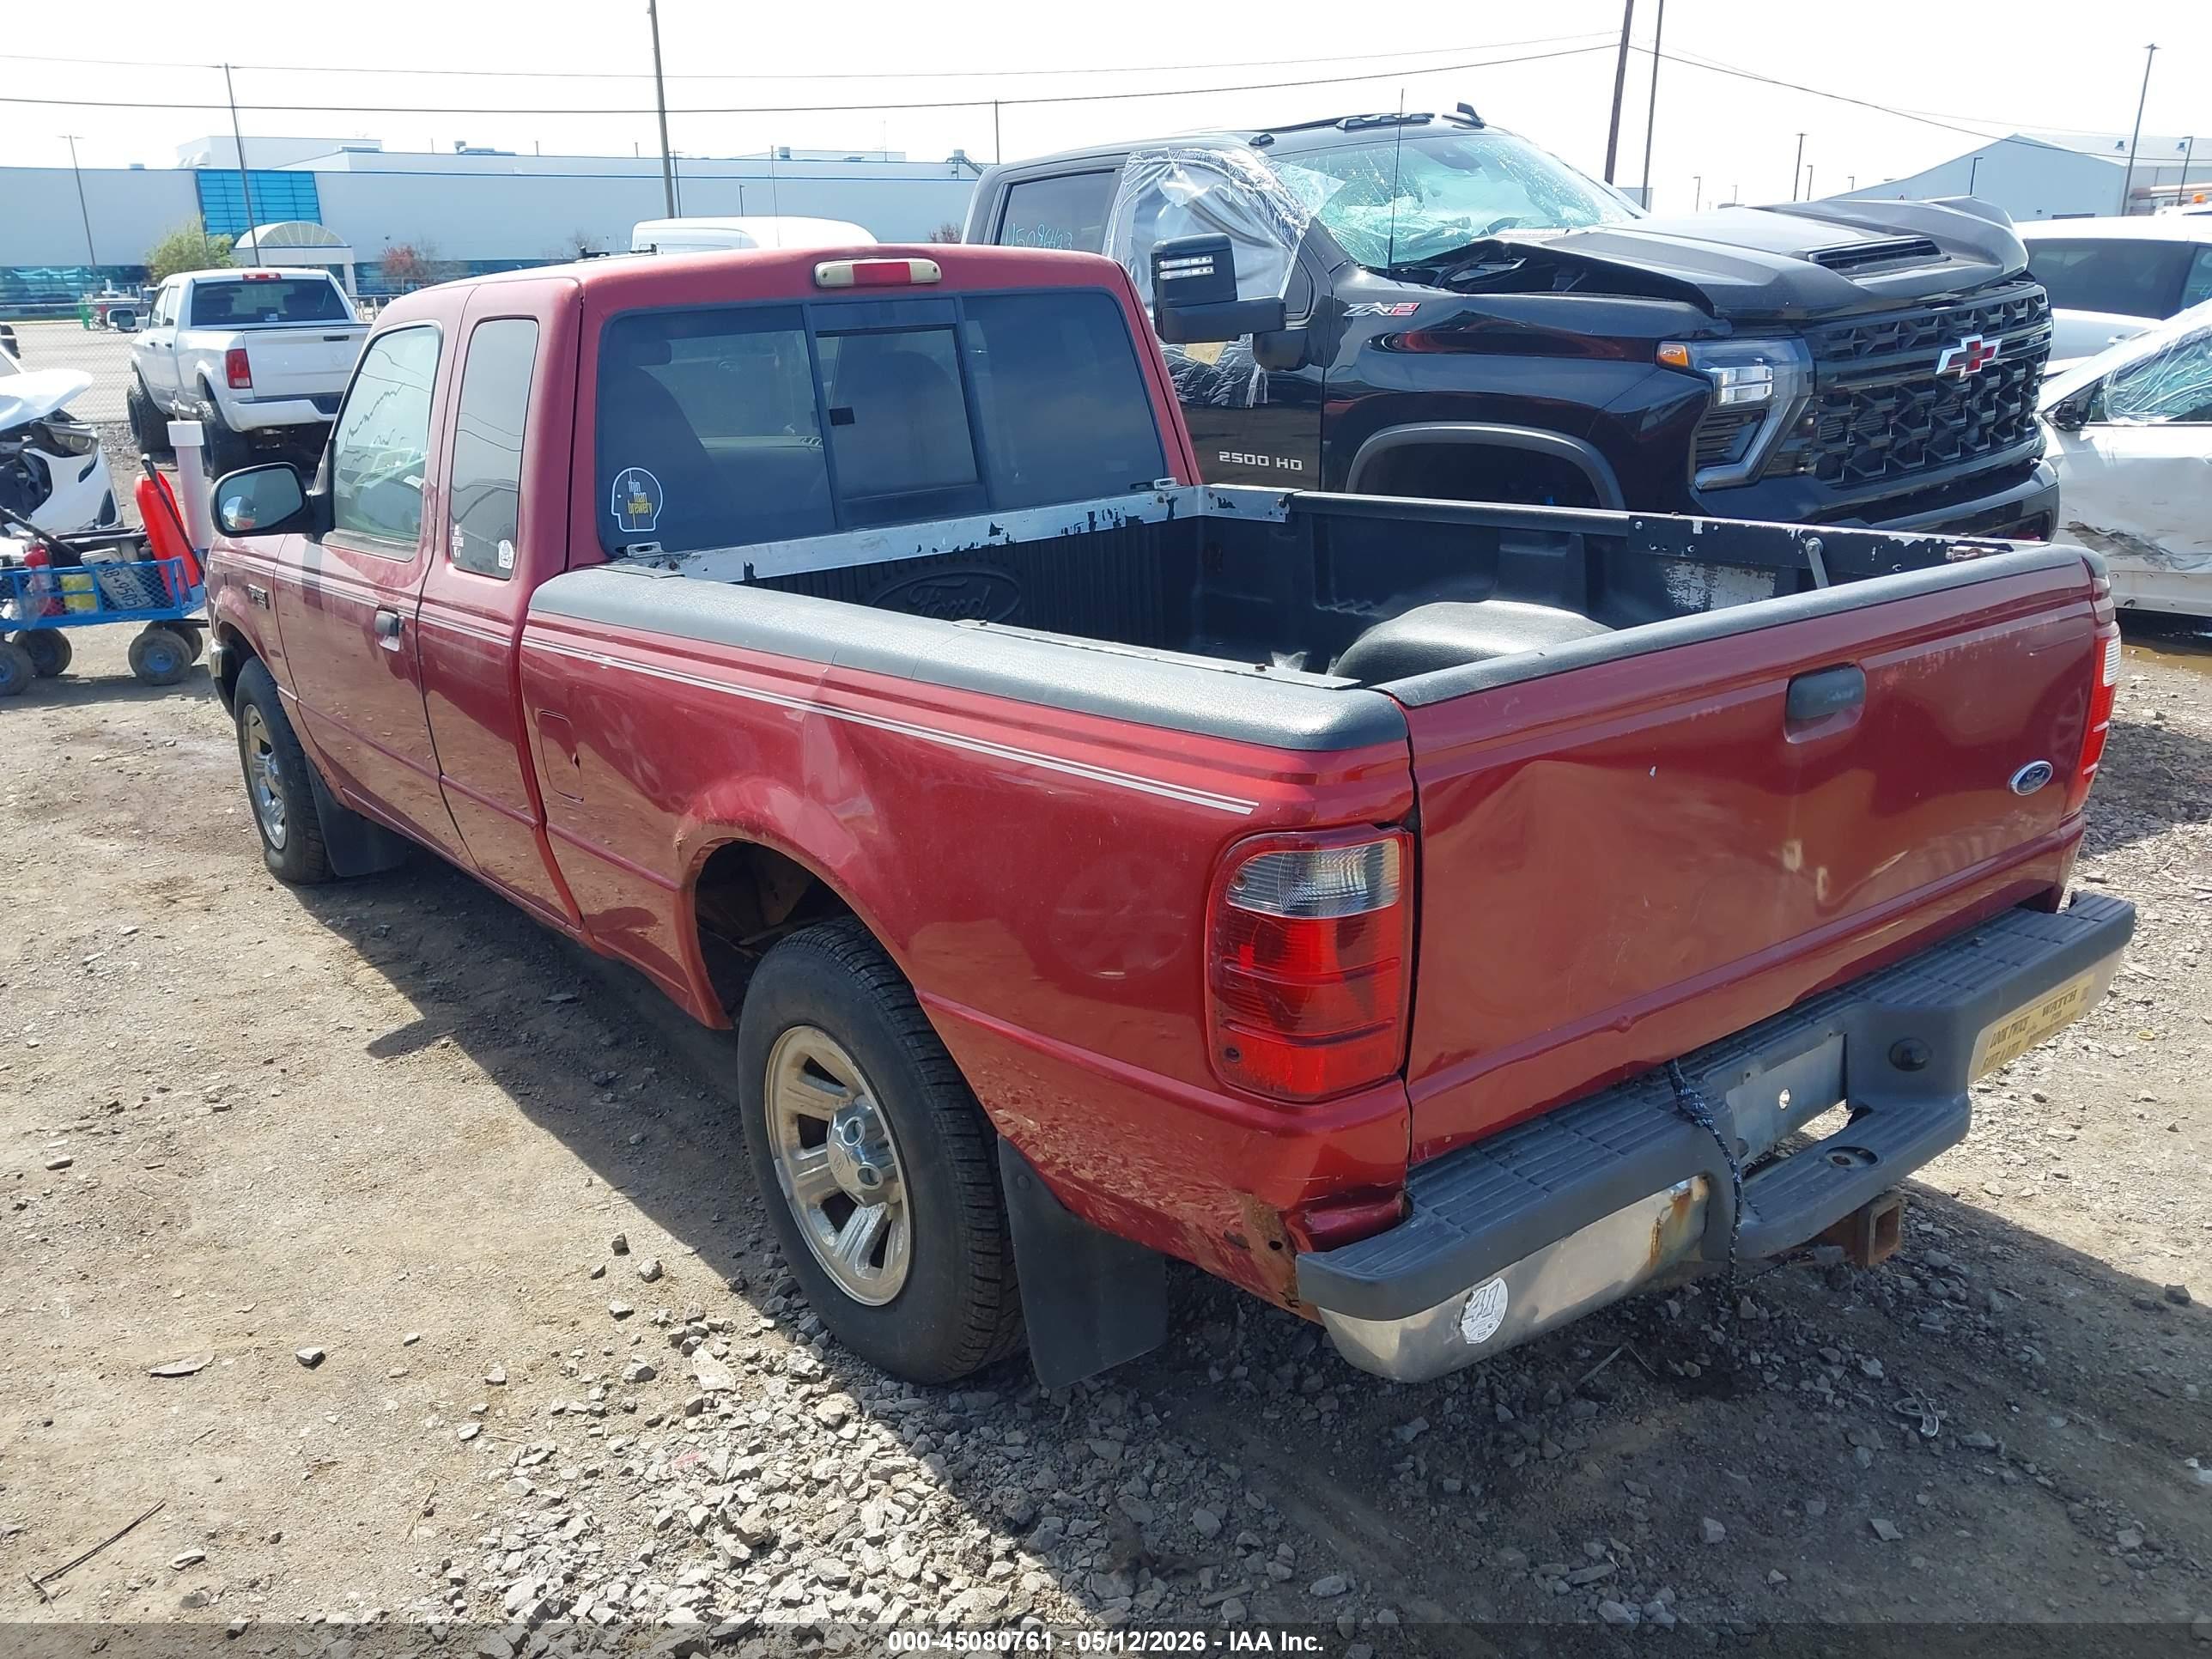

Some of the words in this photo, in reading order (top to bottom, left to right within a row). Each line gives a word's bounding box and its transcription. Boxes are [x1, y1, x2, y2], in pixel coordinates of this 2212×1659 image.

[1218, 451, 1270, 466] 2500
[1276, 457, 1304, 471] HD
[628, 479, 641, 493] thin
[628, 499, 653, 517] brewery
[908, 578, 992, 621] Ford
[2042, 988, 2078, 1018] WATCH
[1462, 1282, 1501, 1322] 41
